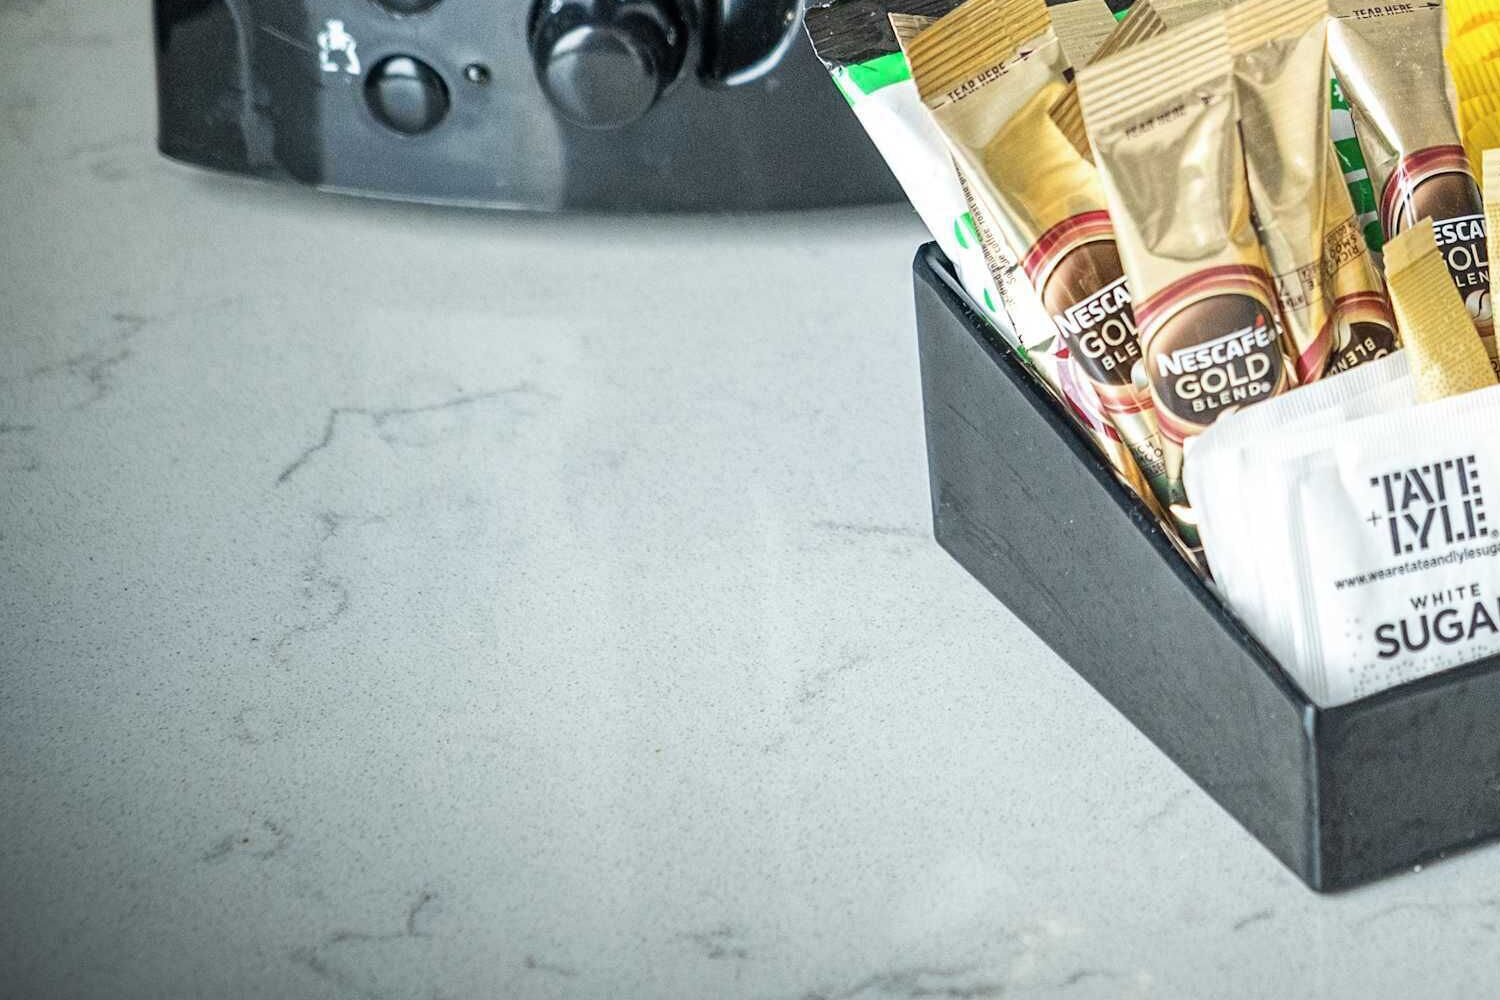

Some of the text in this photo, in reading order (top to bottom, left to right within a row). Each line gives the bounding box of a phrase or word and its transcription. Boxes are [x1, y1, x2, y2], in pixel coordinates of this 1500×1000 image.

[1352, 8, 1384, 19] TEAR
[1175, 352, 1270, 400] GOLD
[1370, 454, 1481, 513] TATE
[1388, 499, 1488, 557] LYLE
[1410, 583, 1482, 611] WHITE
